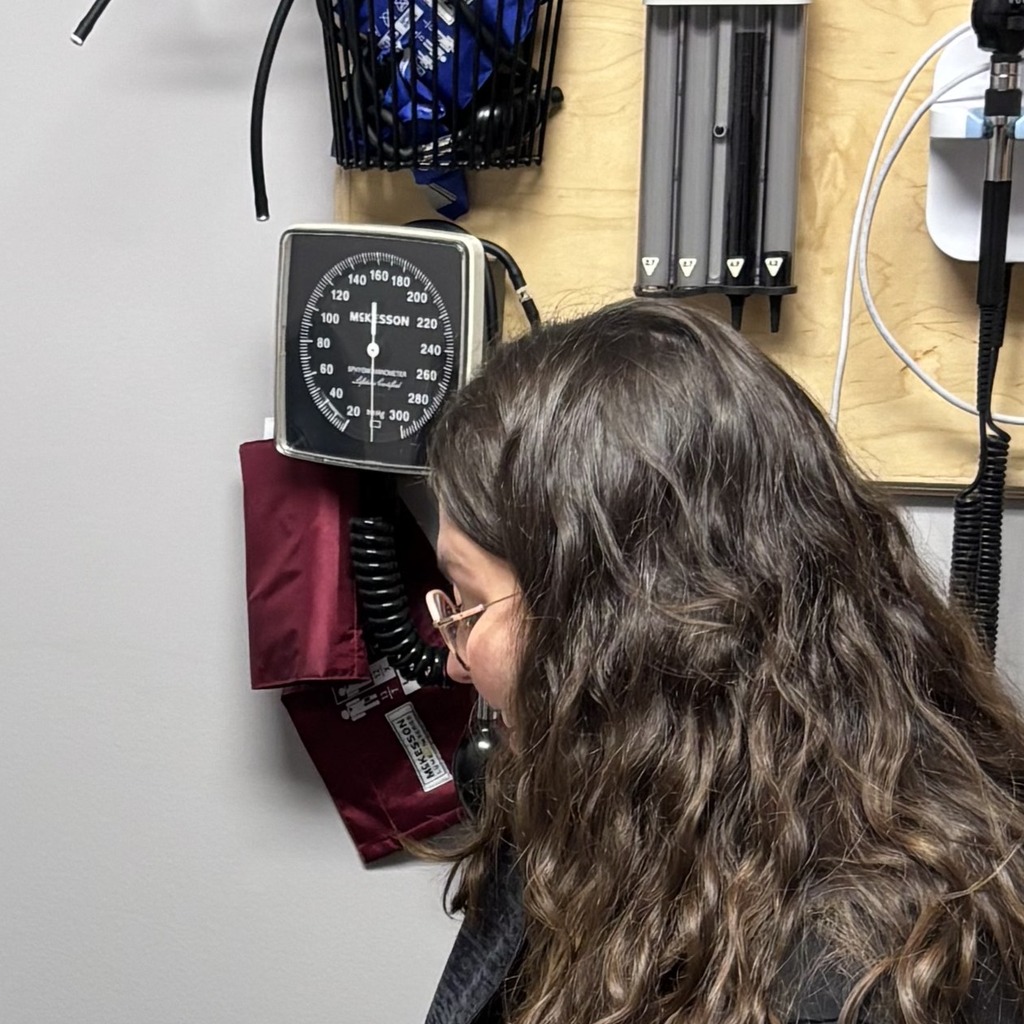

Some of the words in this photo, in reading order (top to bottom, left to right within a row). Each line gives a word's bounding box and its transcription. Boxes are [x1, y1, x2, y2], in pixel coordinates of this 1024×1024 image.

[348, 273, 367, 286] 140
[369, 270, 389, 282] 160
[392, 275, 411, 287] 180
[331, 289, 350, 301] 120
[407, 291, 428, 304] 200
[321, 312, 340, 325] 100
[416, 317, 438, 330] 220
[317, 338, 331, 349] 80
[420, 344, 442, 356] 240
[320, 364, 333, 376] 60
[416, 369, 438, 382] 260
[329, 387, 344, 399] 40
[408, 393, 429, 406] 280
[346, 405, 361, 417] 20
[388, 409, 410, 422] 300
